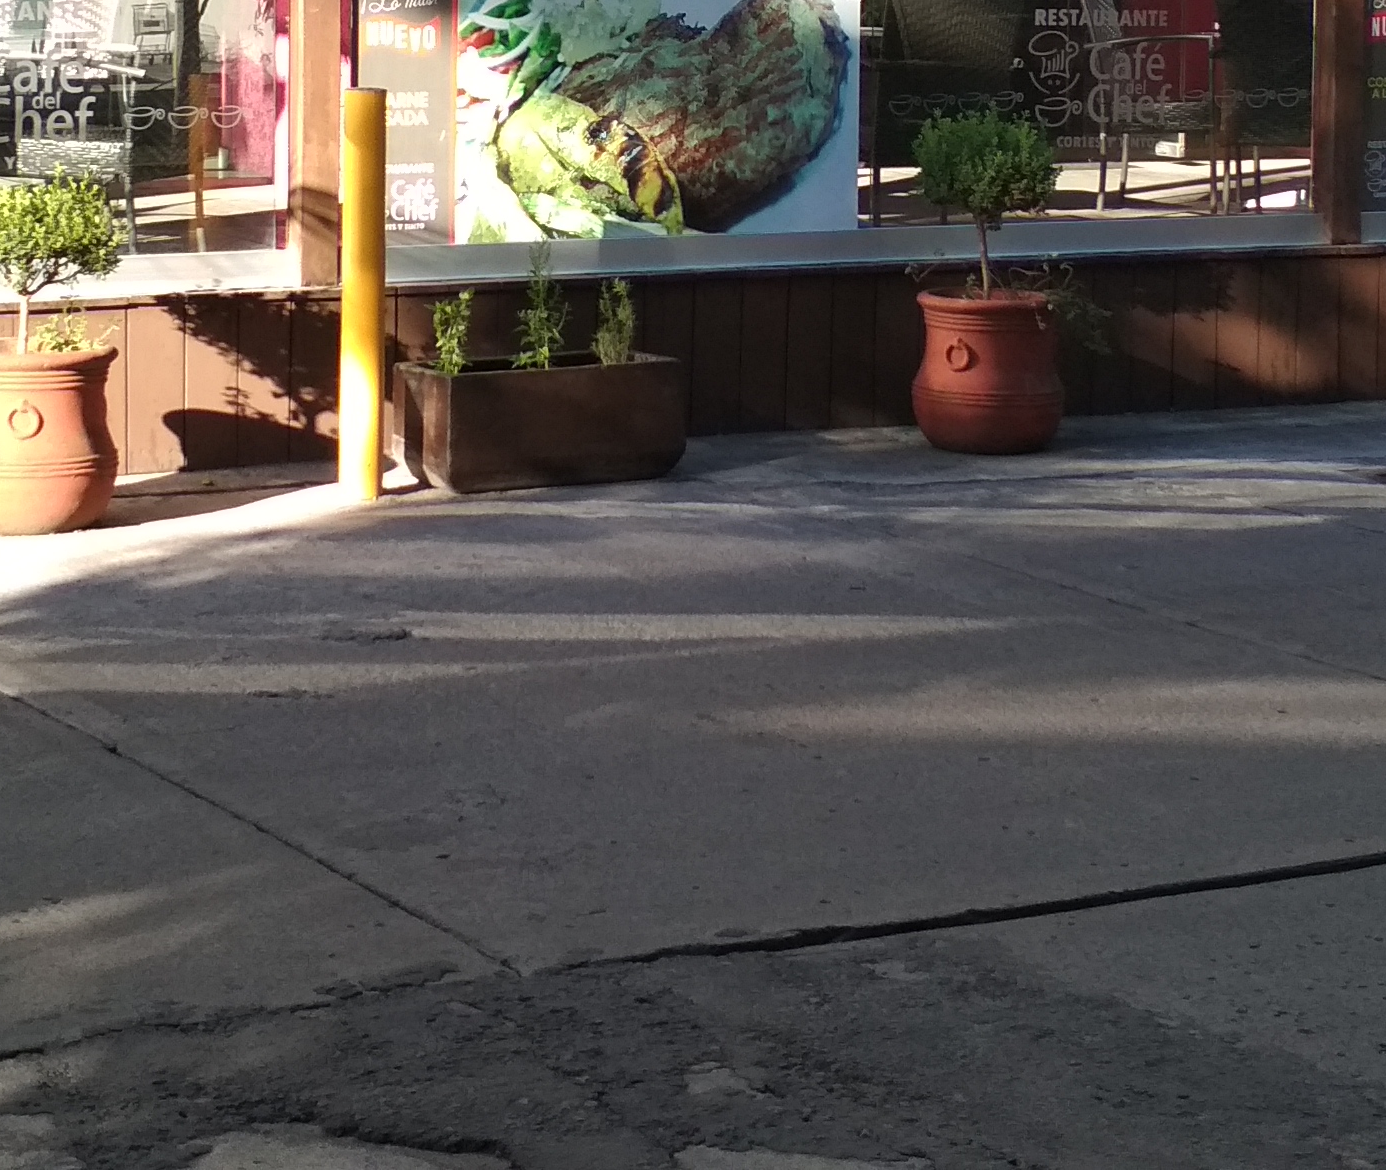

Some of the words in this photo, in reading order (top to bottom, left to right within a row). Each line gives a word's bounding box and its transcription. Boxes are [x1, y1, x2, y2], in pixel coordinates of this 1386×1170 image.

[1034, 8, 1169, 27] RESTAURANTE
[366, 20, 436, 52] NUEVO
[1089, 42, 1165, 80] Café
[1126, 80, 1147, 95] del
[1372, 89, 1380, 98] A
[32, 93, 61, 110] del
[386, 91, 429, 108] ARNE
[1087, 83, 1172, 124] Chef
[385, 109, 429, 127] SADA
[3, 156, 15, 170] Y
[391, 178, 436, 201] Café
[391, 197, 440, 221] Chef
